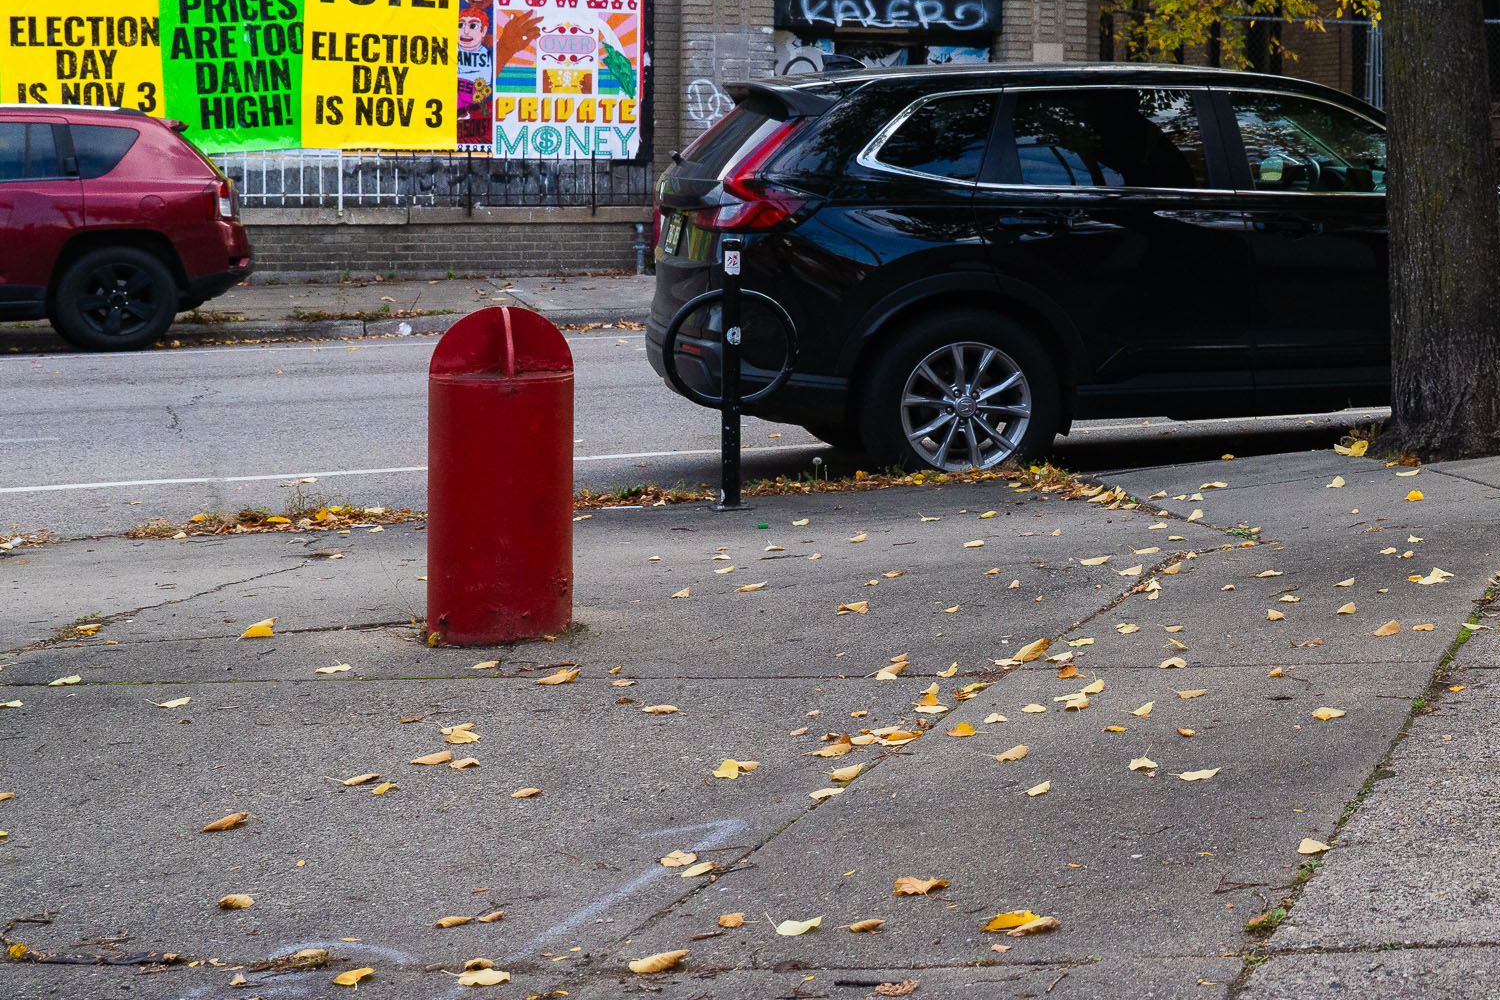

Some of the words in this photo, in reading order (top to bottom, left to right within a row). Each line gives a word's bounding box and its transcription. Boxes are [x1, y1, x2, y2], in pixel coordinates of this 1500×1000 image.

[9, 16, 161, 47] ELECTION
[170, 24, 238, 60] ARE
[243, 21, 304, 57] TOO
[543, 36, 592, 52] OVER
[311, 31, 449, 66] ELECTION
[56, 49, 118, 80] DAY
[195, 58, 292, 95] DAMN
[352, 65, 409, 96] DAY
[17, 83, 46, 104] IS
[62, 82, 125, 107] NOV
[138, 82, 157, 113] 3
[200, 93, 293, 130] HIGH!
[315, 95, 344, 126] IS
[355, 97, 415, 128] NOV
[424, 98, 443, 128] 3
[496, 97, 637, 124] PRIVATE
